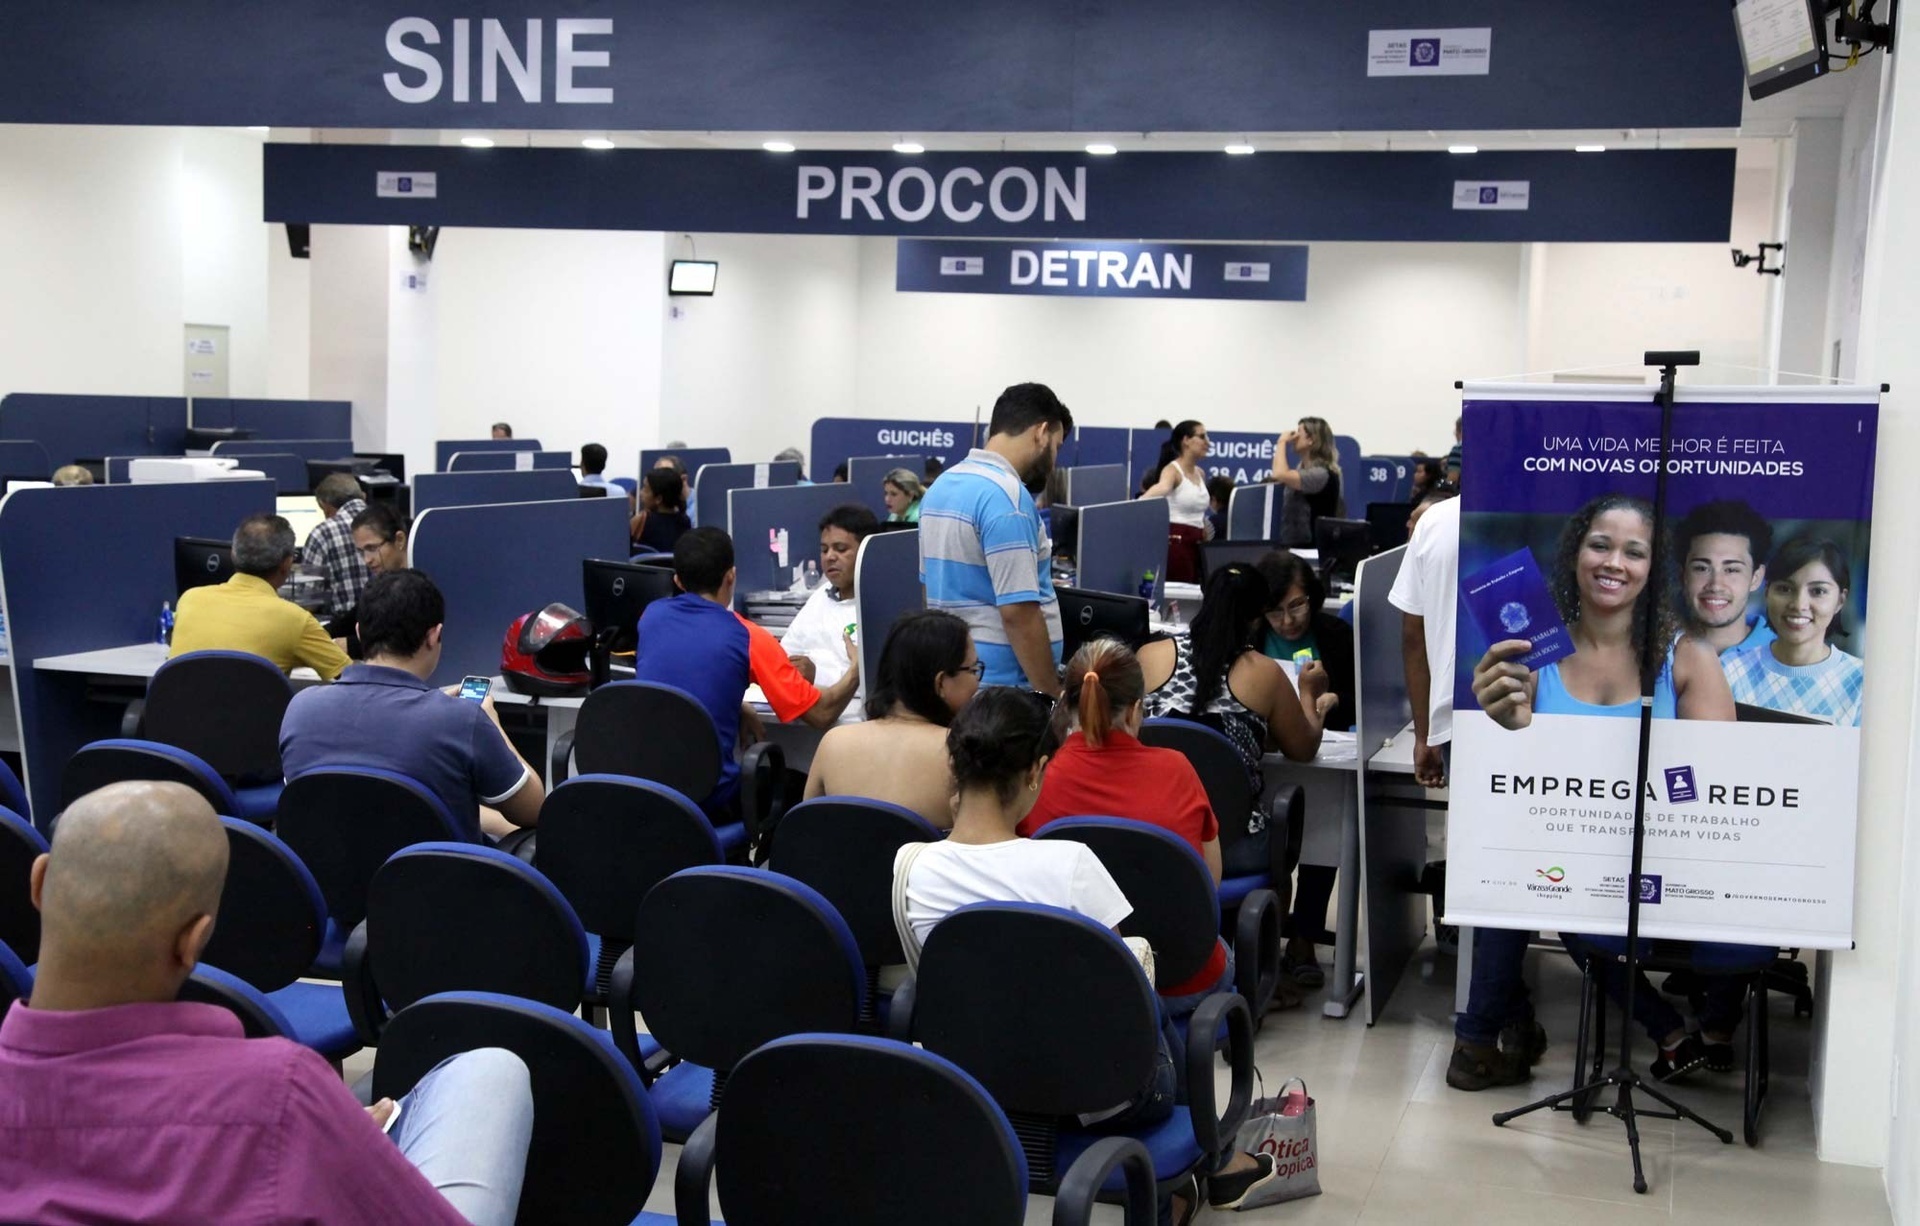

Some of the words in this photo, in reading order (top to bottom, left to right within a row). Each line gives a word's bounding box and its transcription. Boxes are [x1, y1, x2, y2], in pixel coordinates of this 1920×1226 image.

[383, 16, 614, 104] SINE
[796, 165, 1087, 223] PROCON
[1010, 249, 1193, 290] DETRAN
[877, 428, 954, 448] GUICHÊS
[1543, 436, 1583, 451] UMA
[1587, 437, 1630, 452] VIDA
[1635, 438, 1712, 454] MEHOR
[1717, 435, 1728, 454] É
[1733, 439, 1786, 455] FEITA
[1369, 467, 1388, 482] 38
[1523, 457, 1566, 472] COM
[1569, 457, 1636, 473] NOVAS
[1234, 467, 1248, 484] A
[1708, 784, 1800, 808] REDE
[1528, 806, 1651, 822] OPORTUNIDADS
[1657, 813, 1675, 823] DE
[1682, 814, 1760, 827] TRABALHO
[1545, 822, 1574, 833] QUE
[1697, 831, 1742, 842] VIDAS
[1258, 1133, 1309, 1158] Ótica
